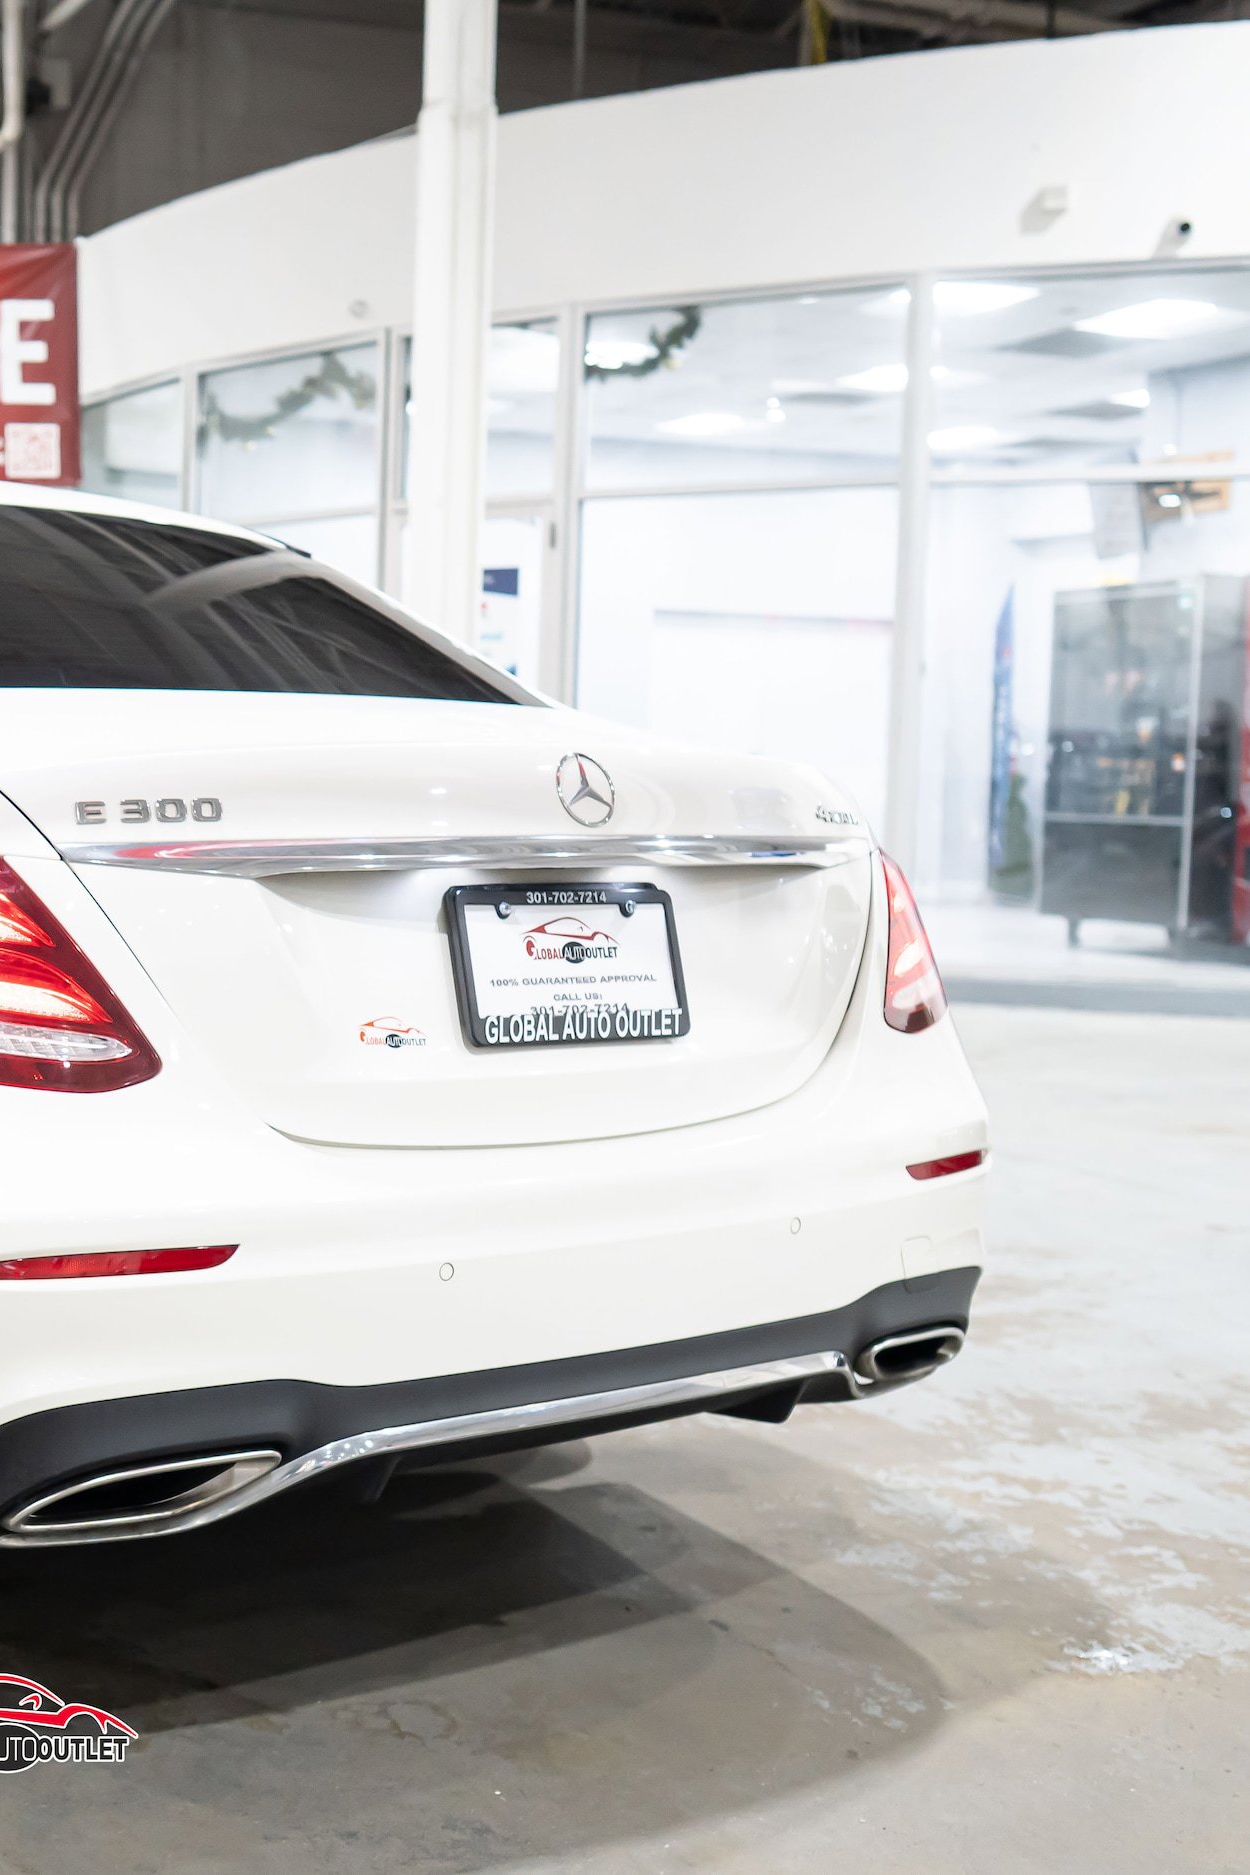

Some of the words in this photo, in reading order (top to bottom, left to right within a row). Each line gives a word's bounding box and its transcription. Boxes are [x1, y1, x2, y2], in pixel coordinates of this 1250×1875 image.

[75, 800, 108, 826] E
[119, 797, 224, 824] 300
[525, 891, 607, 905] 301-702-7214
[490, 979, 519, 987] 100%
[522, 976, 596, 986] GUARANTEED
[600, 974, 657, 983] APPROVAL
[552, 992, 582, 1001] CALL
[485, 1013, 559, 1044] GLOBAL
[562, 1011, 611, 1040] AUTO
[615, 1008, 683, 1038] OUTLET
